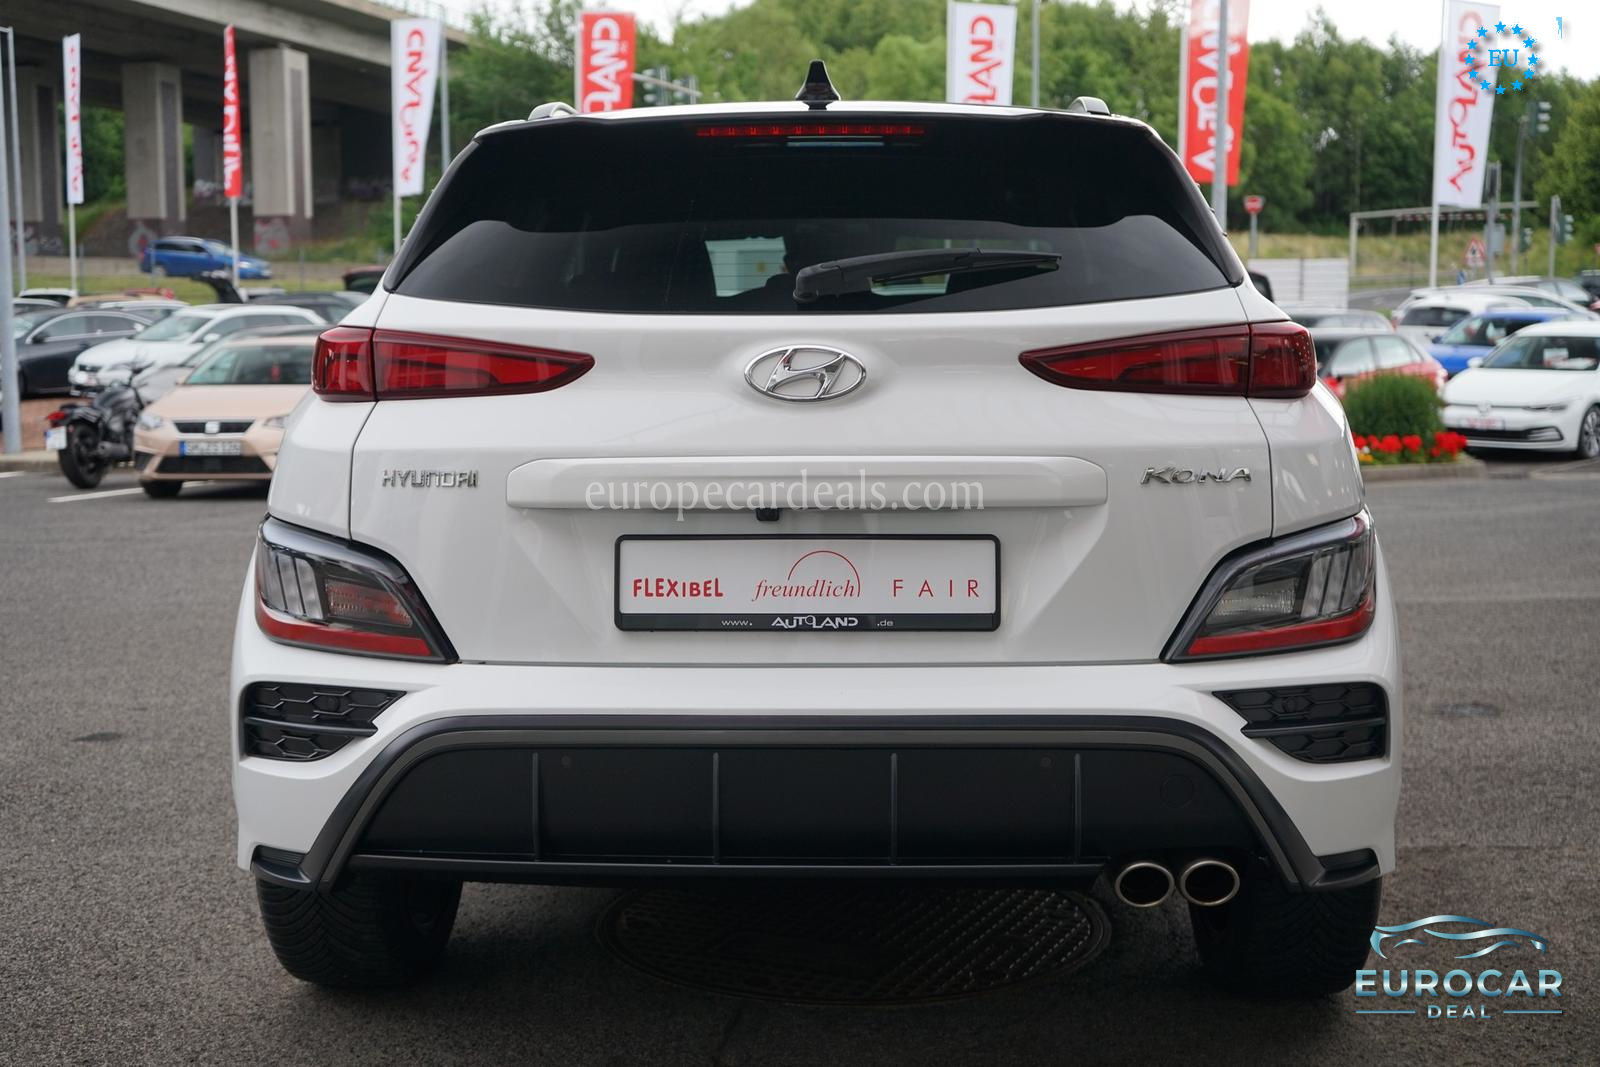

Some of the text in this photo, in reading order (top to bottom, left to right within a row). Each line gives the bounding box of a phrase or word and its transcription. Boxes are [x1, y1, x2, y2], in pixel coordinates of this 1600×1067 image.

[382, 469, 479, 488] HYUNDAI
[1140, 466, 1252, 484] KONA
[633, 578, 980, 603] FLEXIBEL freundlich FAIR
[721, 614, 894, 629] www. AUTOLAND .de
